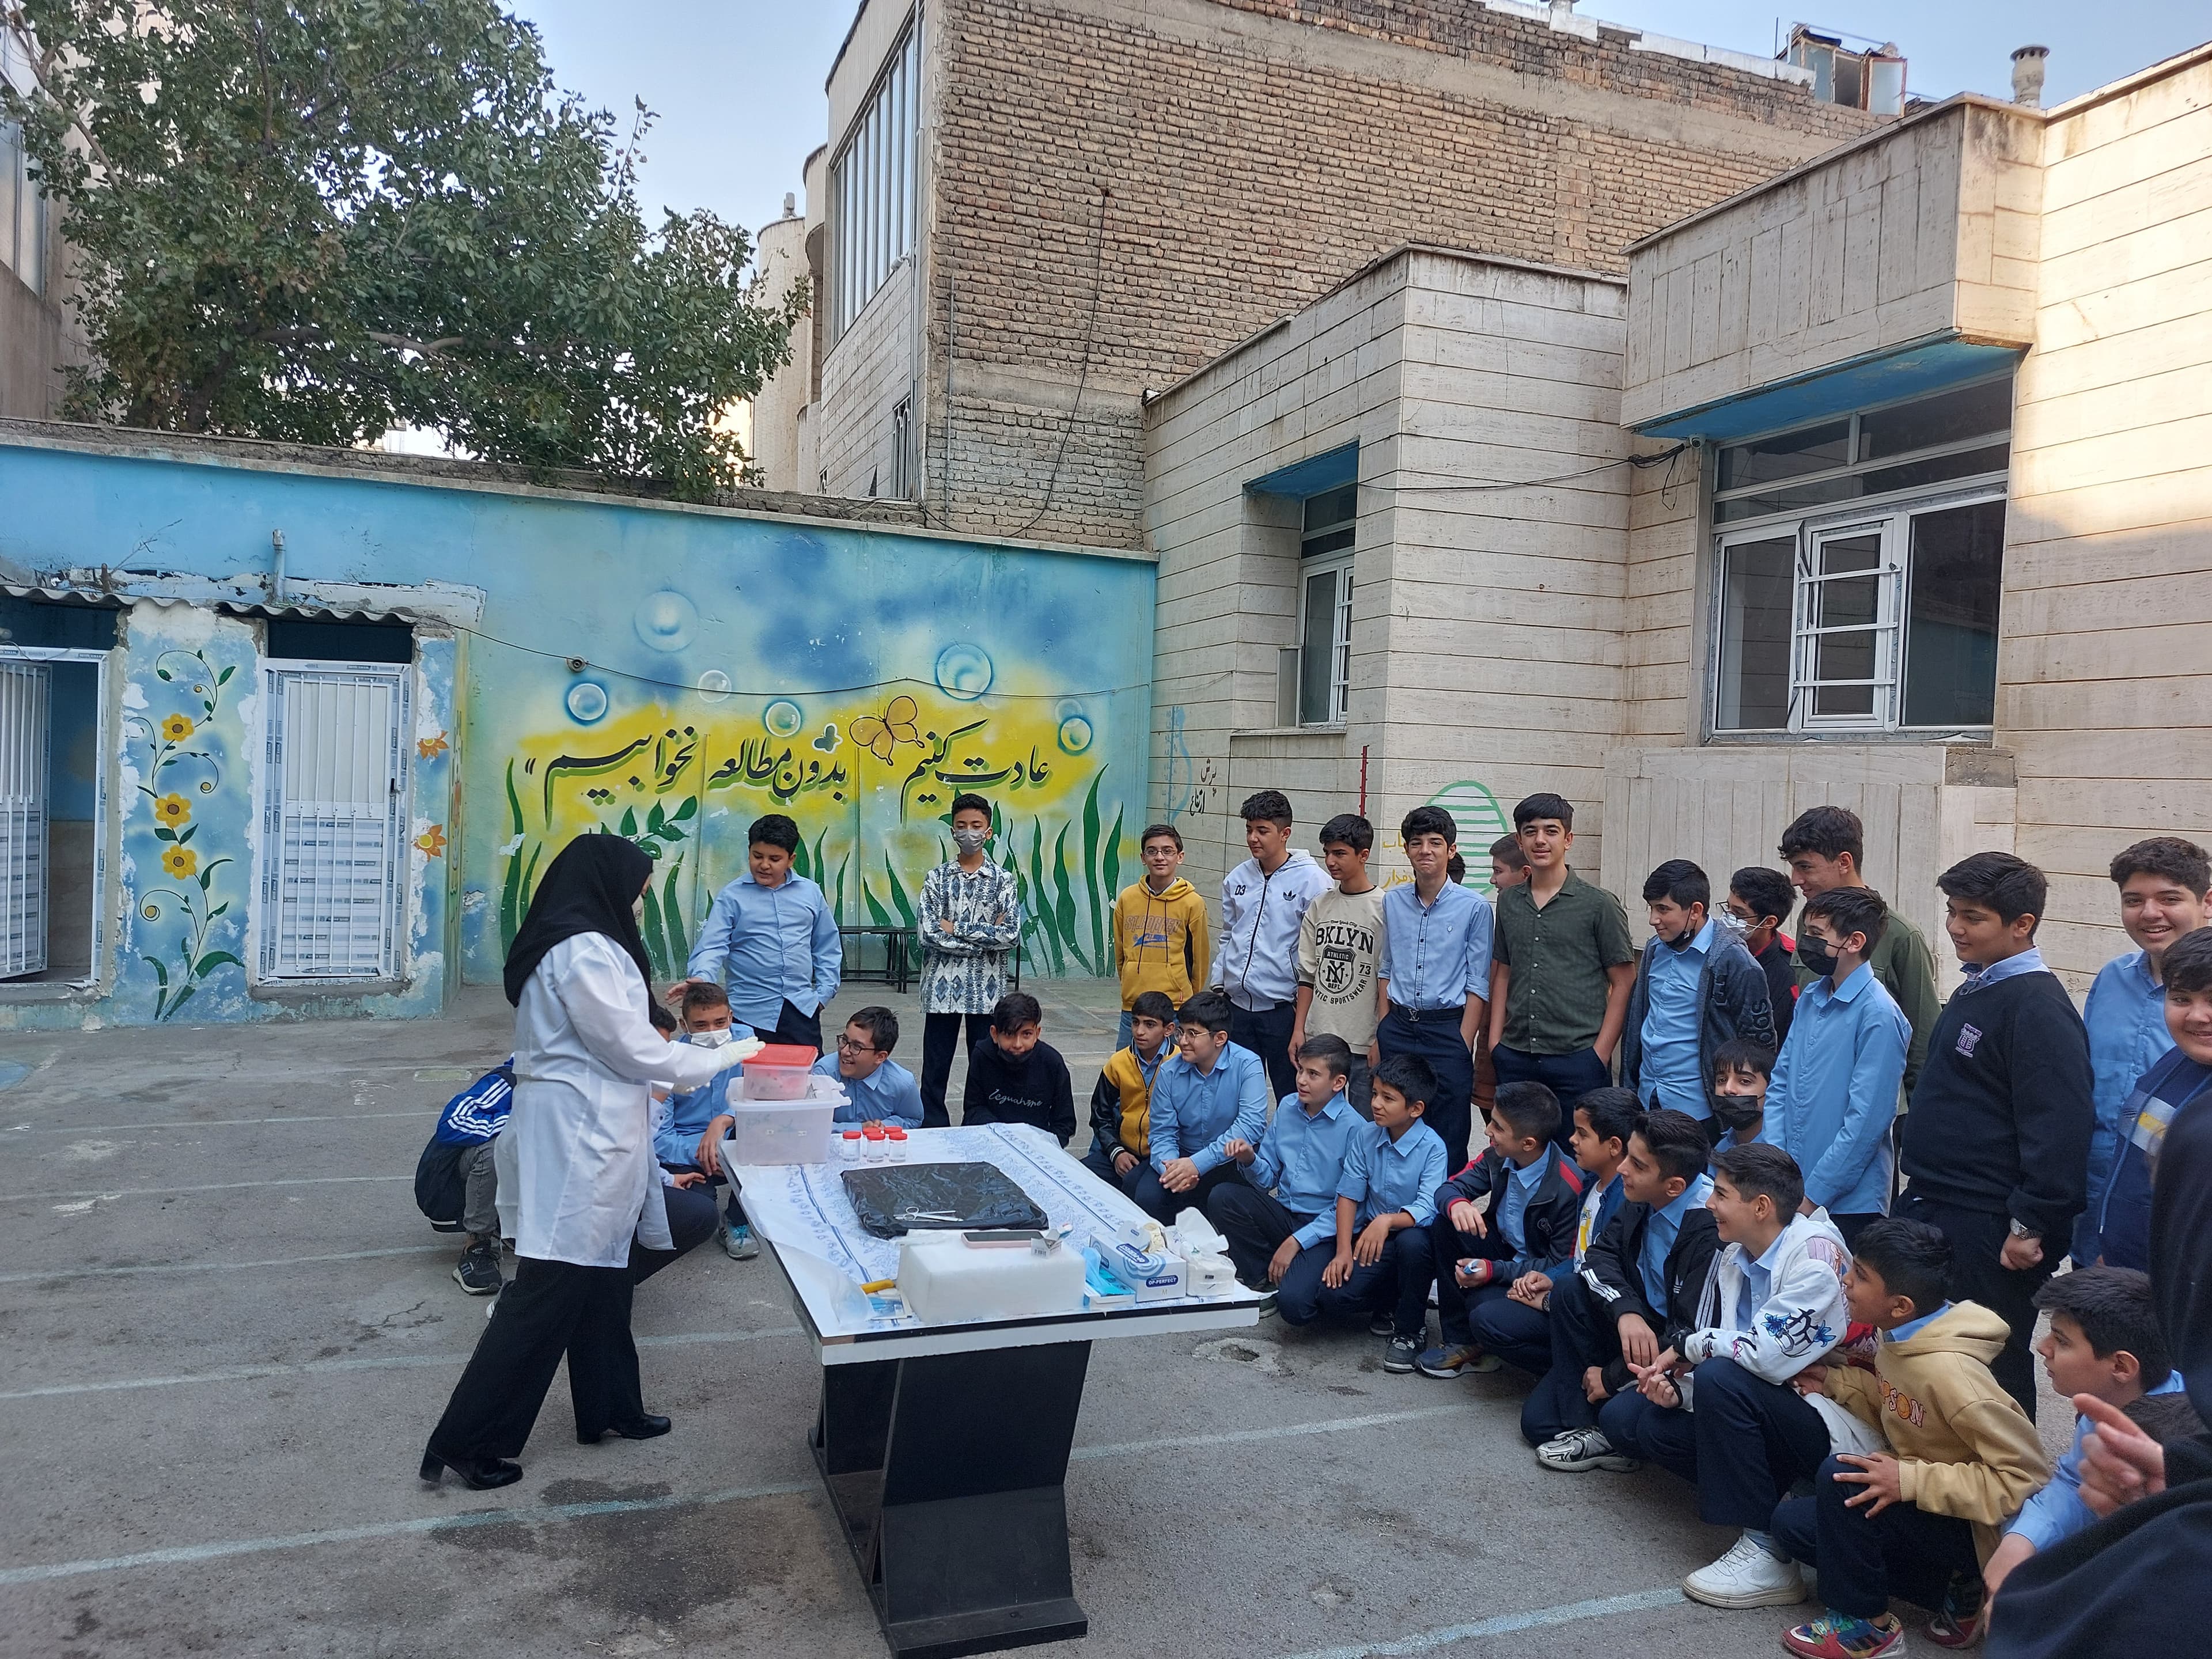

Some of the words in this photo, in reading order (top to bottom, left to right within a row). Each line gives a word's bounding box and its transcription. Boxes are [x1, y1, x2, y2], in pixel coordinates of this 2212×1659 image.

[708, 737, 793, 783] مطالعه
[900, 718, 989, 825] کنیم
[934, 745, 1050, 786] عادت
[772, 758, 847, 801] بدون
[1316, 926, 1374, 955] BKLYN
[1327, 951, 1350, 960] ATHLETIC
[1359, 964, 1372, 975] 73
[1330, 979, 1368, 1005] SPORTSWEAR
